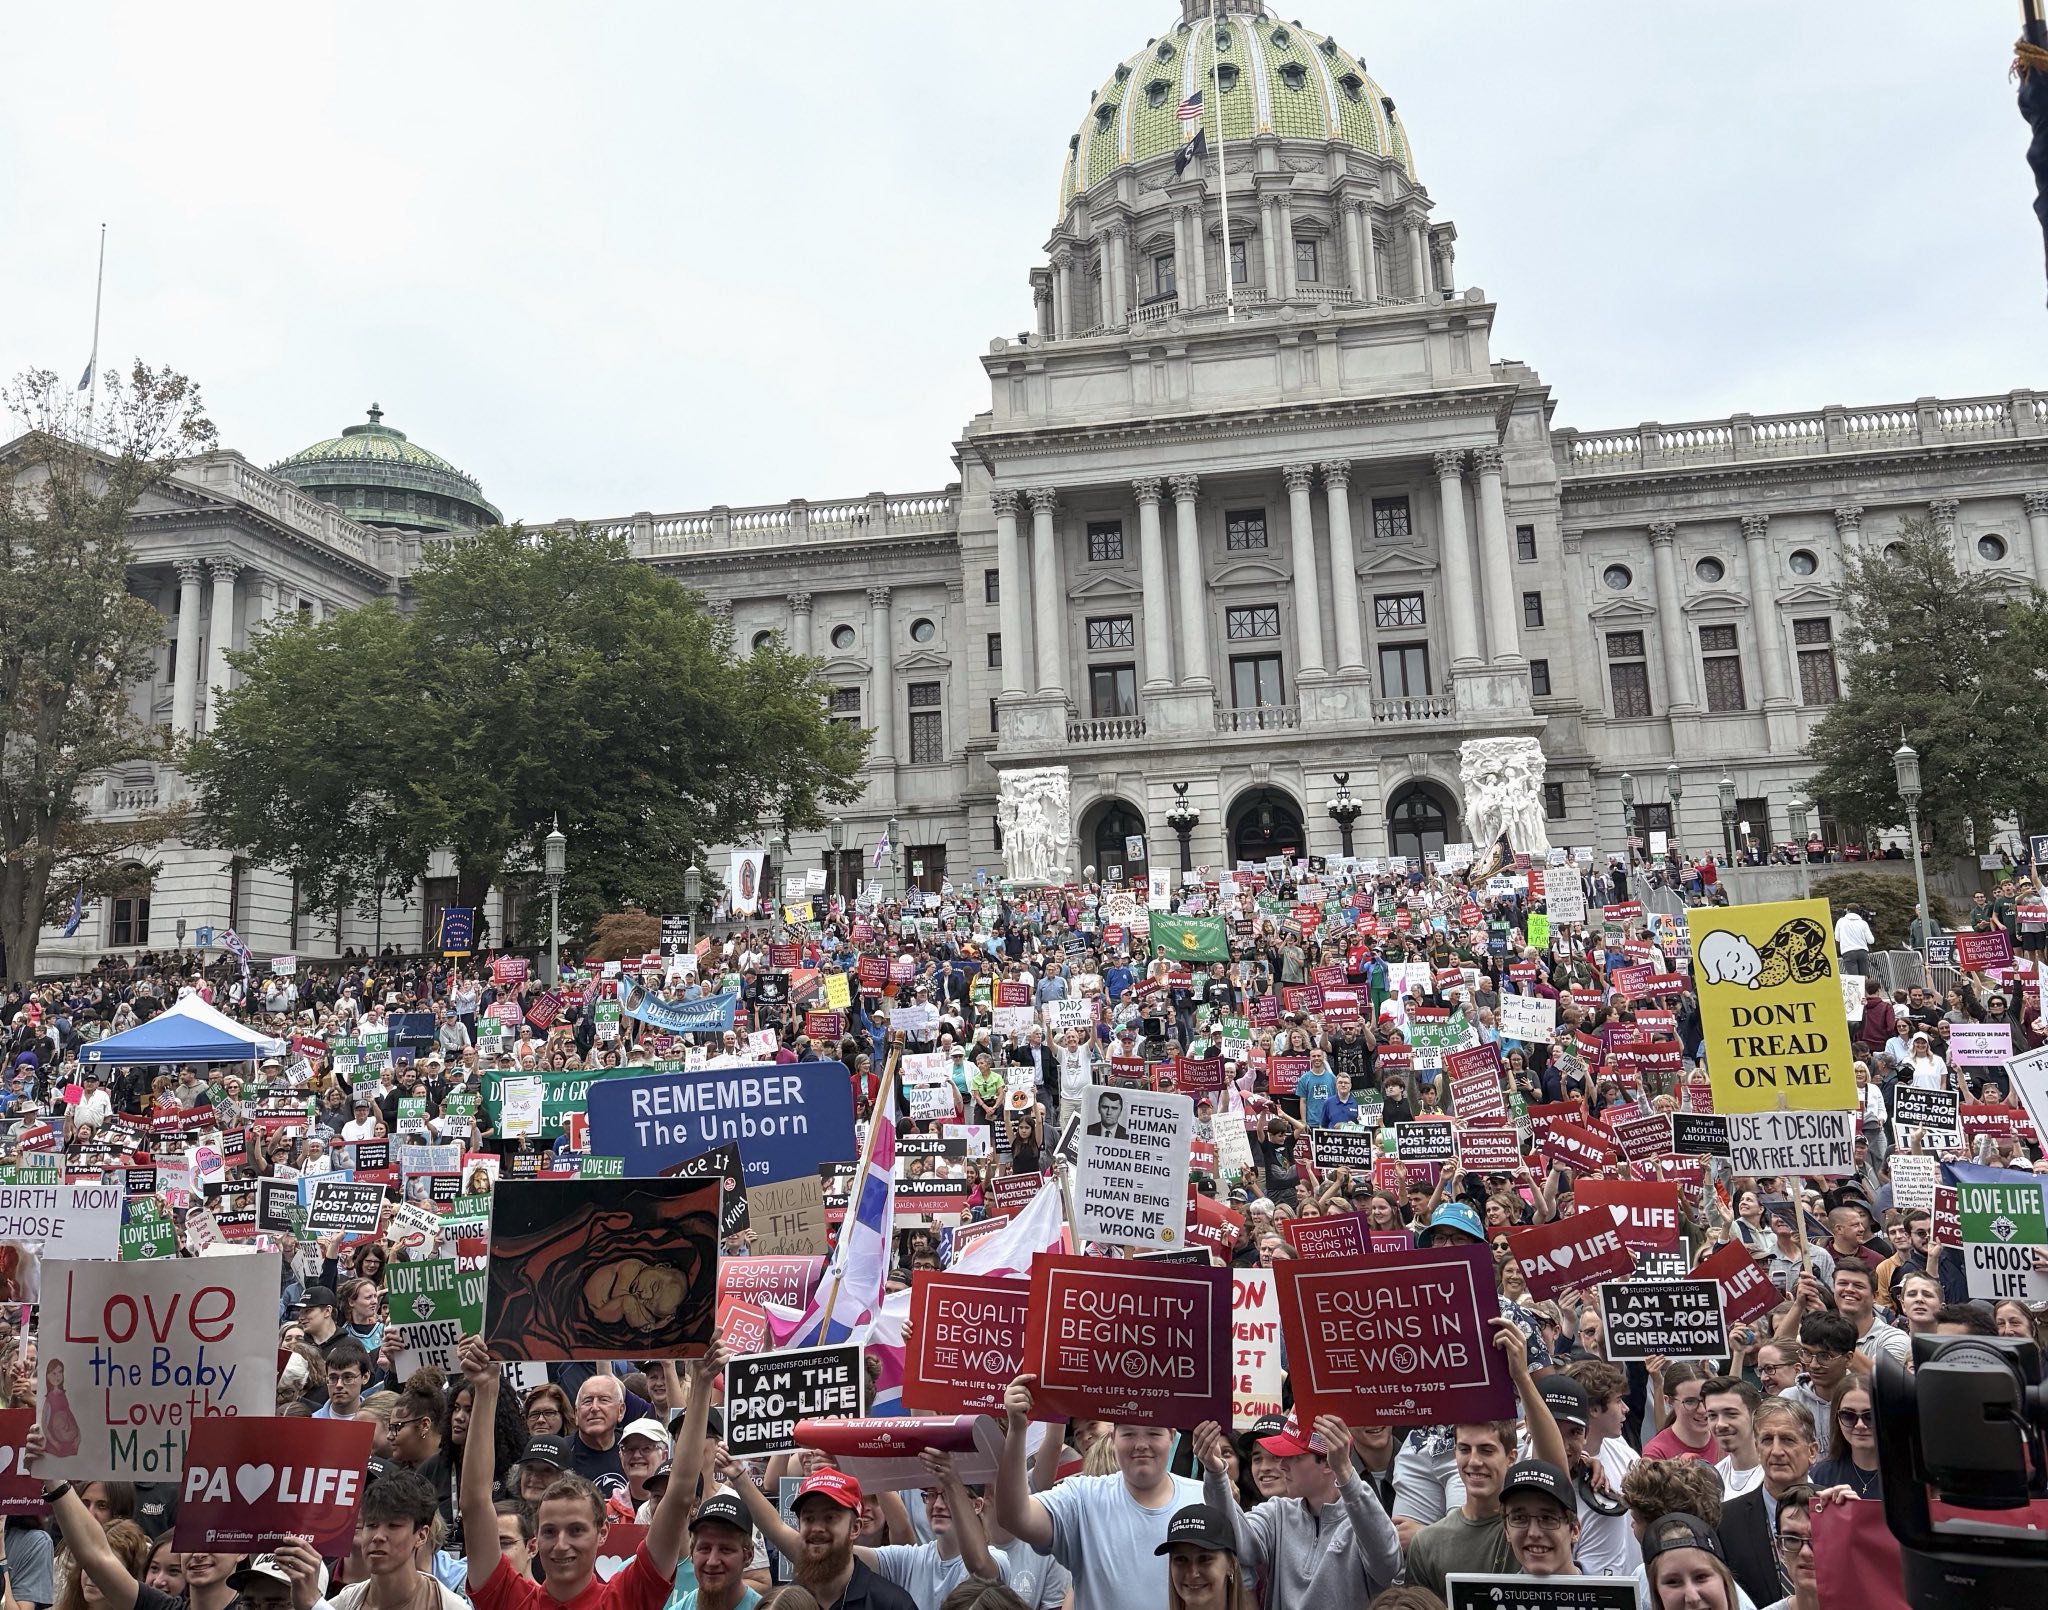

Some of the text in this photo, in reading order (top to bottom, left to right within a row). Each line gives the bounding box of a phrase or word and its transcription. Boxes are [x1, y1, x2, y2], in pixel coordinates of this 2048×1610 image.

[597, 1004, 619, 1013] LOVE LIFE
[647, 1003, 704, 1022] DEFENDING
[1058, 1001, 1082, 1011] DADS
[1056, 1018, 1091, 1028] SOMETHING
[1730, 1002, 1816, 1028] DONT
[597, 1023, 617, 1031] CHOOSE
[1224, 1019, 1249, 1028] LOVE LIFE
[601, 1031, 612, 1040] LIFE
[1224, 1039, 1246, 1050] CHOOSE
[1727, 1033, 1828, 1058] TREAD
[1228, 1050, 1240, 1059] LIFE
[1734, 1064, 1831, 1088] ON ME
[631, 1076, 804, 1117] REMEMBER
[1128, 1119, 1177, 1134] HUMAN
[1963, 1115, 2009, 1124] PA LIFE
[635, 1112, 808, 1147] The Unborn
[1685, 1127, 1725, 1135] ABOLISH
[1728, 1116, 1844, 1142] USE DESIGN
[1129, 1134, 1171, 1148] BEING
[1681, 1135, 1728, 1143] ABORTION
[895, 1142, 946, 1153] Pro-Life
[1095, 1146, 1150, 1162] TODDLER
[1461, 1147, 1518, 1155] PROTECTION
[1548, 1132, 1604, 1163] PA LIFE
[1476, 1156, 1518, 1164] CONCEPTION
[1732, 1142, 1852, 1171] FOR FREE. SEE ME!
[582, 1159, 622, 1175] LOVE LIFE
[1087, 1159, 1170, 1177] HUMAN BEING
[1103, 1177, 1134, 1189] TEEN
[72, 1190, 118, 1209] MOM
[329, 1190, 348, 1199] AM
[353, 1192, 377, 1201] THE
[1086, 1188, 1170, 1207] HUMAN BEING
[1962, 1189, 2040, 1214] LOVE LIFE
[314, 1201, 379, 1214] POST-ROE
[918, 1201, 949, 1209] AMERICA
[313, 1214, 375, 1224] GENERATION
[1084, 1204, 1165, 1225] PROVE ME
[1631, 1208, 1676, 1228] LIFE
[445, 1223, 484, 1241] CHOOSE
[769, 1211, 809, 1237] THE
[1100, 1223, 1155, 1240] WRONG
[124, 1222, 172, 1244] LOVE LIFE
[1299, 1226, 1354, 1242] EQUALITY
[1301, 1236, 1356, 1252] BEGINS IN
[1520, 1230, 1622, 1279] PA LIFE
[1974, 1246, 2040, 1271] CHOOSE
[390, 1263, 454, 1294] LOVE LIFE
[728, 1264, 802, 1279] EQUALITY
[725, 1276, 798, 1289] BEGINS IN
[1630, 1285, 1700, 1294] STUDENTSFORLIFE.ORG
[1993, 1274, 2028, 1298] LIFE
[743, 1291, 798, 1306] WOMB
[1063, 1289, 1193, 1320] EQUALITY
[1315, 1281, 1455, 1319] EQUALITY
[1611, 1294, 1710, 1310] I AM THE
[64, 1270, 237, 1344] Love
[1609, 1309, 1719, 1329] POST-ROE
[399, 1321, 458, 1350] CHOOSE
[1061, 1318, 1193, 1349] BEGINS IN
[1320, 1313, 1461, 1342] BEGINS IN
[936, 1324, 1012, 1348] BEGINS
[1614, 1331, 1720, 1347] GENERATION
[759, 1356, 839, 1373] STUDENTSFORLIFE.ORG
[935, 1351, 958, 1365] THE
[1059, 1350, 1195, 1378] THE WOMB
[1237, 1350, 1266, 1368] IT
[1328, 1343, 1469, 1374] THE WOMB
[89, 1346, 237, 1400] the Baby
[737, 1366, 849, 1395] I AM THE
[1082, 1385, 1170, 1397] Text LIFE to 73075
[1354, 1381, 1446, 1394] Text LIFE to 73075
[105, 1387, 183, 1426] Love
[730, 1385, 857, 1421] PRO-LIFE
[1244, 1402, 1281, 1416] CHILD
[1099, 1408, 1127, 1416] MARCH
[1376, 1407, 1433, 1416] MARCH LIFE
[846, 1419, 920, 1428] Text LIFE to 73075
[184, 1467, 360, 1506] PA LIFE
[257, 1531, 315, 1543] pafamily.org
[1504, 1590, 1596, 1602] STUDENTS FOR LIFE
